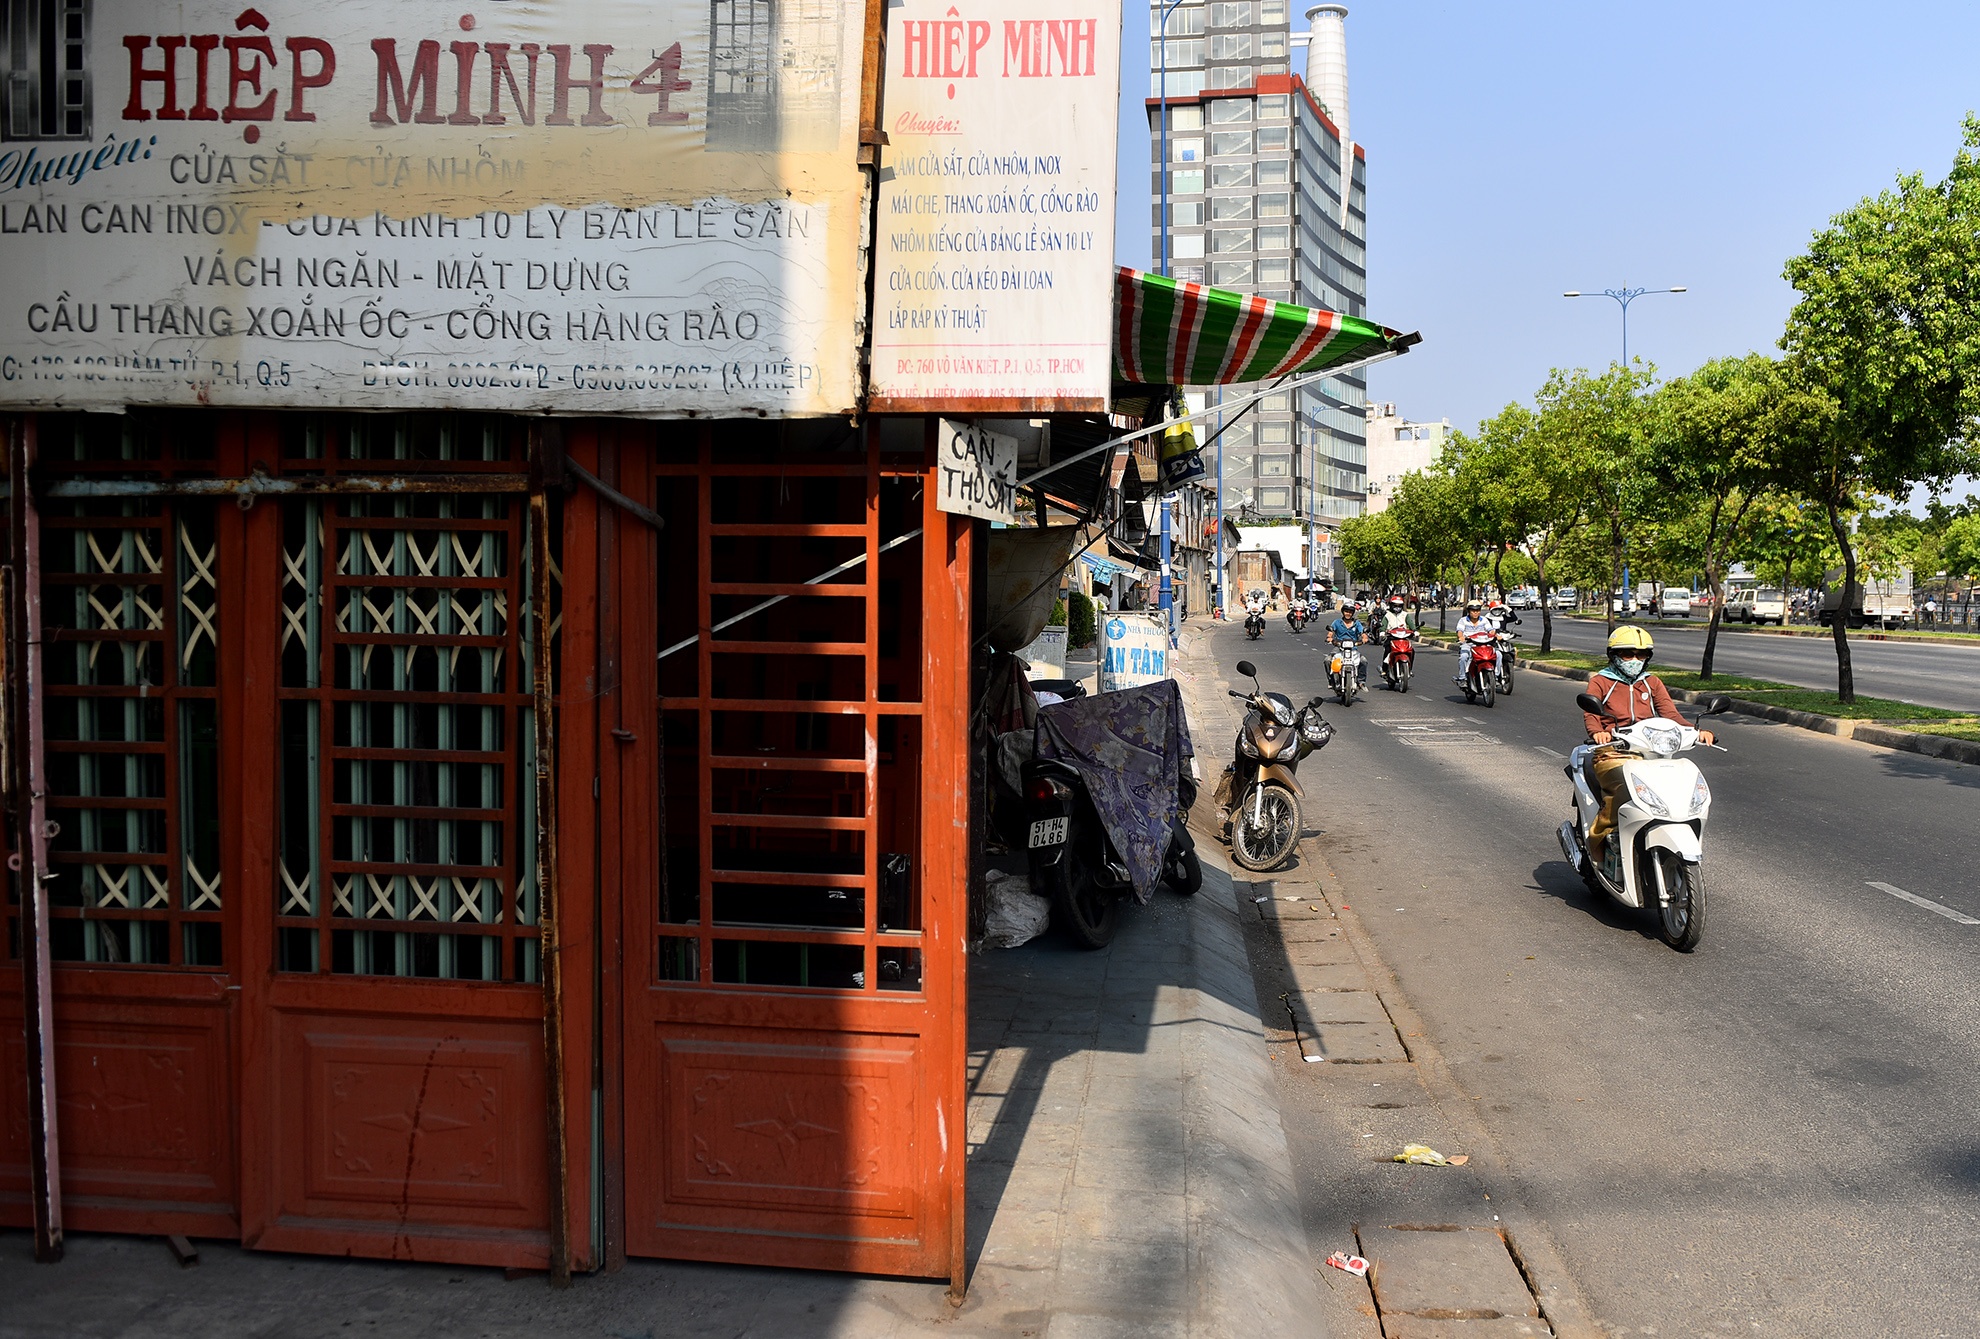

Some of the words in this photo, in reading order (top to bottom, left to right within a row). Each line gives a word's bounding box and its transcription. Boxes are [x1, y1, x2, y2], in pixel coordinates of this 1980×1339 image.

[902, 5, 991, 100] HIỆP
[1002, 18, 1098, 78] MINH
[122, 8, 336, 144] HIỆP
[630, 41, 693, 127] 4
[894, 111, 960, 136] Chuyên:
[0, 133, 157, 193] Chuyên:
[170, 143, 236, 184] CỬA
[249, 141, 313, 185] SẮT
[918, 150, 940, 176] CỬA
[968, 150, 990, 176] CỬA
[1034, 155, 1061, 176] INOX
[890, 189, 912, 214] MÁI
[945, 194, 983, 214] THANG
[1040, 184, 1073, 214] CỔNG
[1076, 187, 1098, 212] RÀO
[1, 204, 67, 235] LAN
[81, 204, 152, 235] CAN
[166, 204, 251, 236] INOX
[525, 210, 567, 240] LY
[890, 228, 925, 252] NHÔM
[965, 226, 988, 252] CỬA
[1040, 226, 1062, 251] SÀN
[1065, 232, 1078, 250] 10
[1080, 231, 1094, 250] LY
[184, 248, 283, 288] VÁCH
[297, 249, 399, 289] NGĂN
[436, 252, 513, 296] MẶT
[526, 257, 631, 297] DỰNG
[889, 264, 912, 291] CỬA
[951, 264, 974, 291] CỬA
[977, 265, 998, 290] KÉO
[1001, 265, 1021, 290] ĐÀI
[1024, 270, 1053, 290] LOAN
[27, 291, 98, 334] CẦU
[110, 304, 234, 337] THANG
[246, 293, 346, 338] XOẮN
[359, 297, 411, 339] ỐC
[446, 294, 552, 342] CỔNG
[566, 303, 670, 342] HÀNG
[684, 302, 760, 341] RÀO
[889, 300, 908, 329] LẮP
[911, 304, 931, 329] RÁP
[951, 304, 987, 333] THUẬT
[917, 359, 934, 374] 760
[1047, 358, 1085, 375] TP.HCM
[952, 424, 995, 466] CẦN
[985, 459, 1016, 514] SẮT
[1104, 646, 1126, 673] AN
[1130, 642, 1165, 676] TÂM
[1033, 831, 1063, 847] 0486
